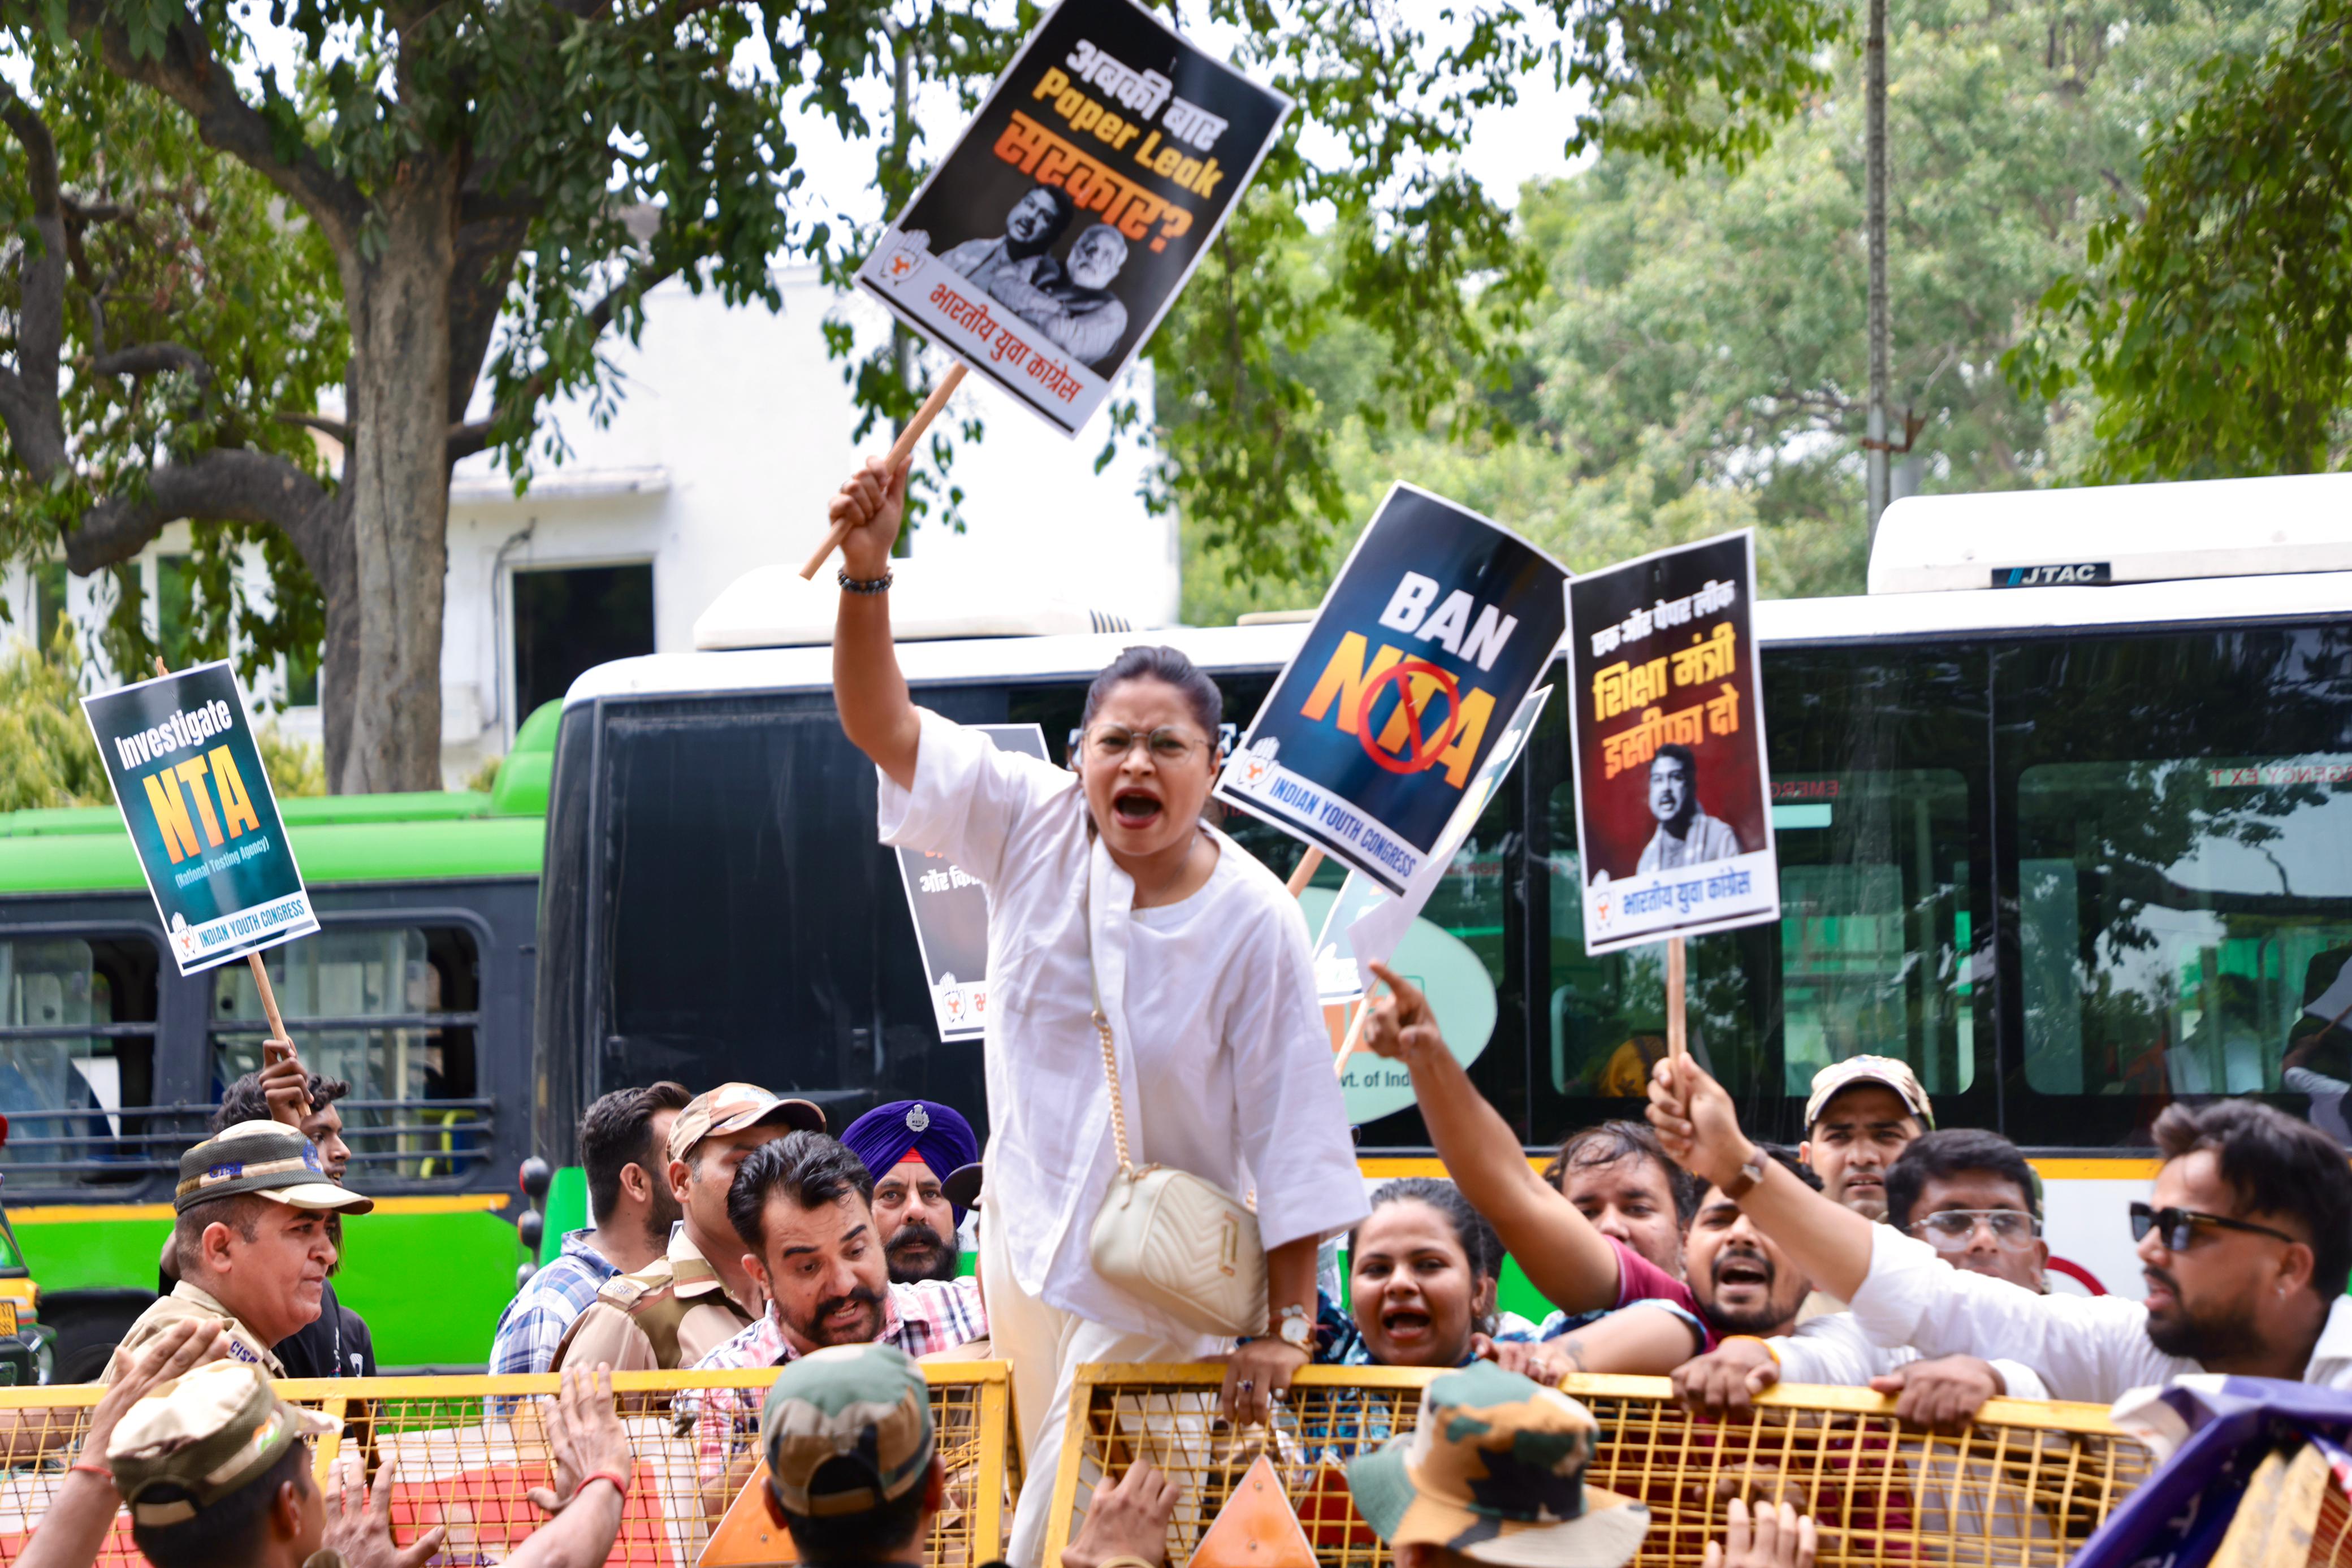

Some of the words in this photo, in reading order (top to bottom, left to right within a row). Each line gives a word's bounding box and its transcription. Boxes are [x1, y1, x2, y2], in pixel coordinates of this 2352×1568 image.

[1031, 66, 1140, 151] Paper
[1134, 129, 1224, 199] Leak
[1066, 38, 1173, 120] अबकी
[1162, 96, 1229, 151] बार
[993, 109, 1193, 253] सरकार?
[929, 283, 999, 342] भारतीय
[991, 327, 1031, 366] युवा
[1026, 352, 1083, 404] कांग्रेस
[1378, 570, 1519, 672] BAN
[1590, 624, 1620, 657] एक
[1620, 608, 1653, 643] और
[1653, 599, 1692, 630] पेपर
[1692, 579, 1735, 618] लीक
[2022, 564, 2096, 584] JTAC
[1300, 630, 1497, 790] NTA
[1592, 660, 1668, 722] शिक्षा
[1671, 621, 1736, 686] मंत्री
[115, 700, 232, 770] Investigate
[1602, 706, 1704, 779] इस्तीफा
[1706, 682, 1739, 736] दो
[142, 744, 260, 864] NTA
[1269, 776, 1320, 815] INDIAN
[1318, 800, 1364, 842] YOUTH
[1360, 828, 1417, 877] CONGRESS
[175, 863, 210, 889] (National
[210, 852, 241, 873] Testing
[240, 835, 269, 860] Agency)
[919, 869, 949, 893] और
[1623, 880, 1673, 915] भारतीय
[1676, 880, 1704, 913] युवा
[1706, 867, 1751, 899] कांग्रेस
[198, 925, 230, 947] INDIAN
[229, 916, 262, 938] YOUTH
[261, 899, 305, 928] CONGRESS
[1341, 1072, 1359, 1088] vt.
[1364, 1070, 1380, 1088] of
[1385, 1071, 1410, 1087] Ind
[607, 1283, 633, 1295] CISF
